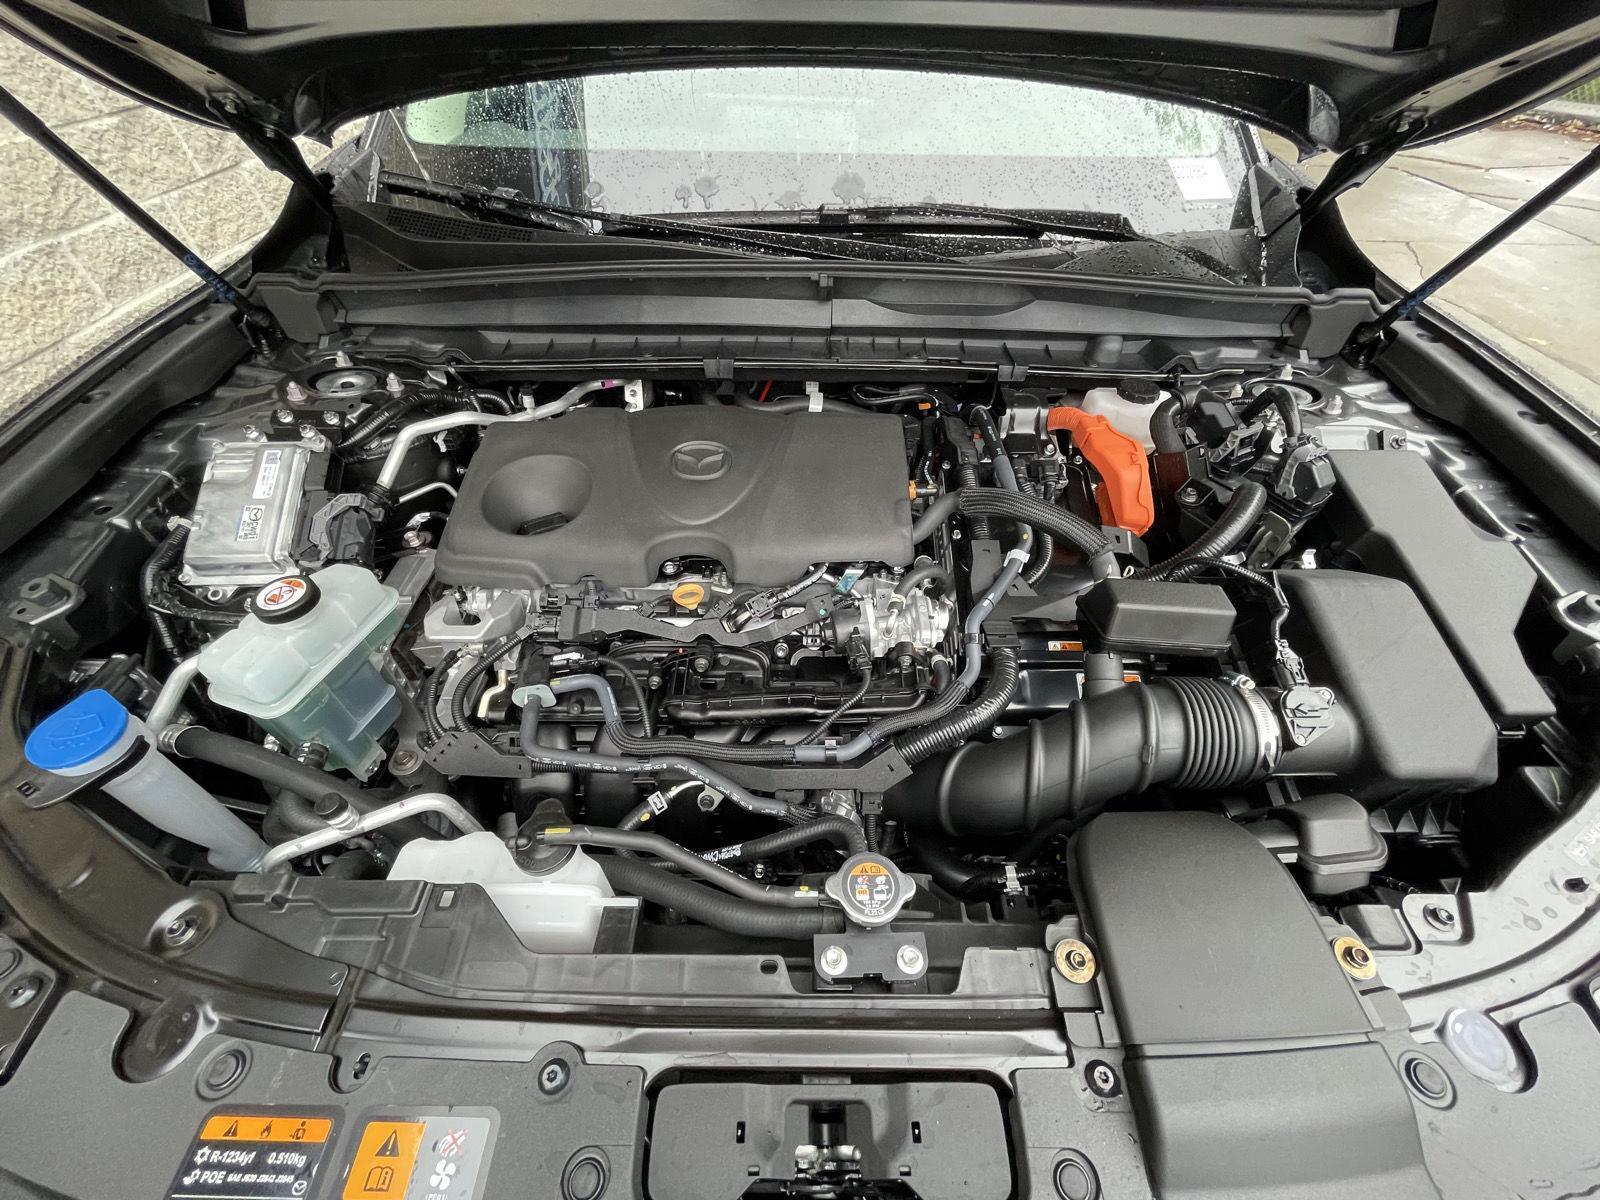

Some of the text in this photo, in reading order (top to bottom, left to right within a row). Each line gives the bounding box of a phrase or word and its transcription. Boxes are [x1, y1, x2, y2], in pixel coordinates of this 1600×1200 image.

[210, 1151, 307, 1168] R-1234yf 0.510kg
[200, 1171, 226, 1184] POE
